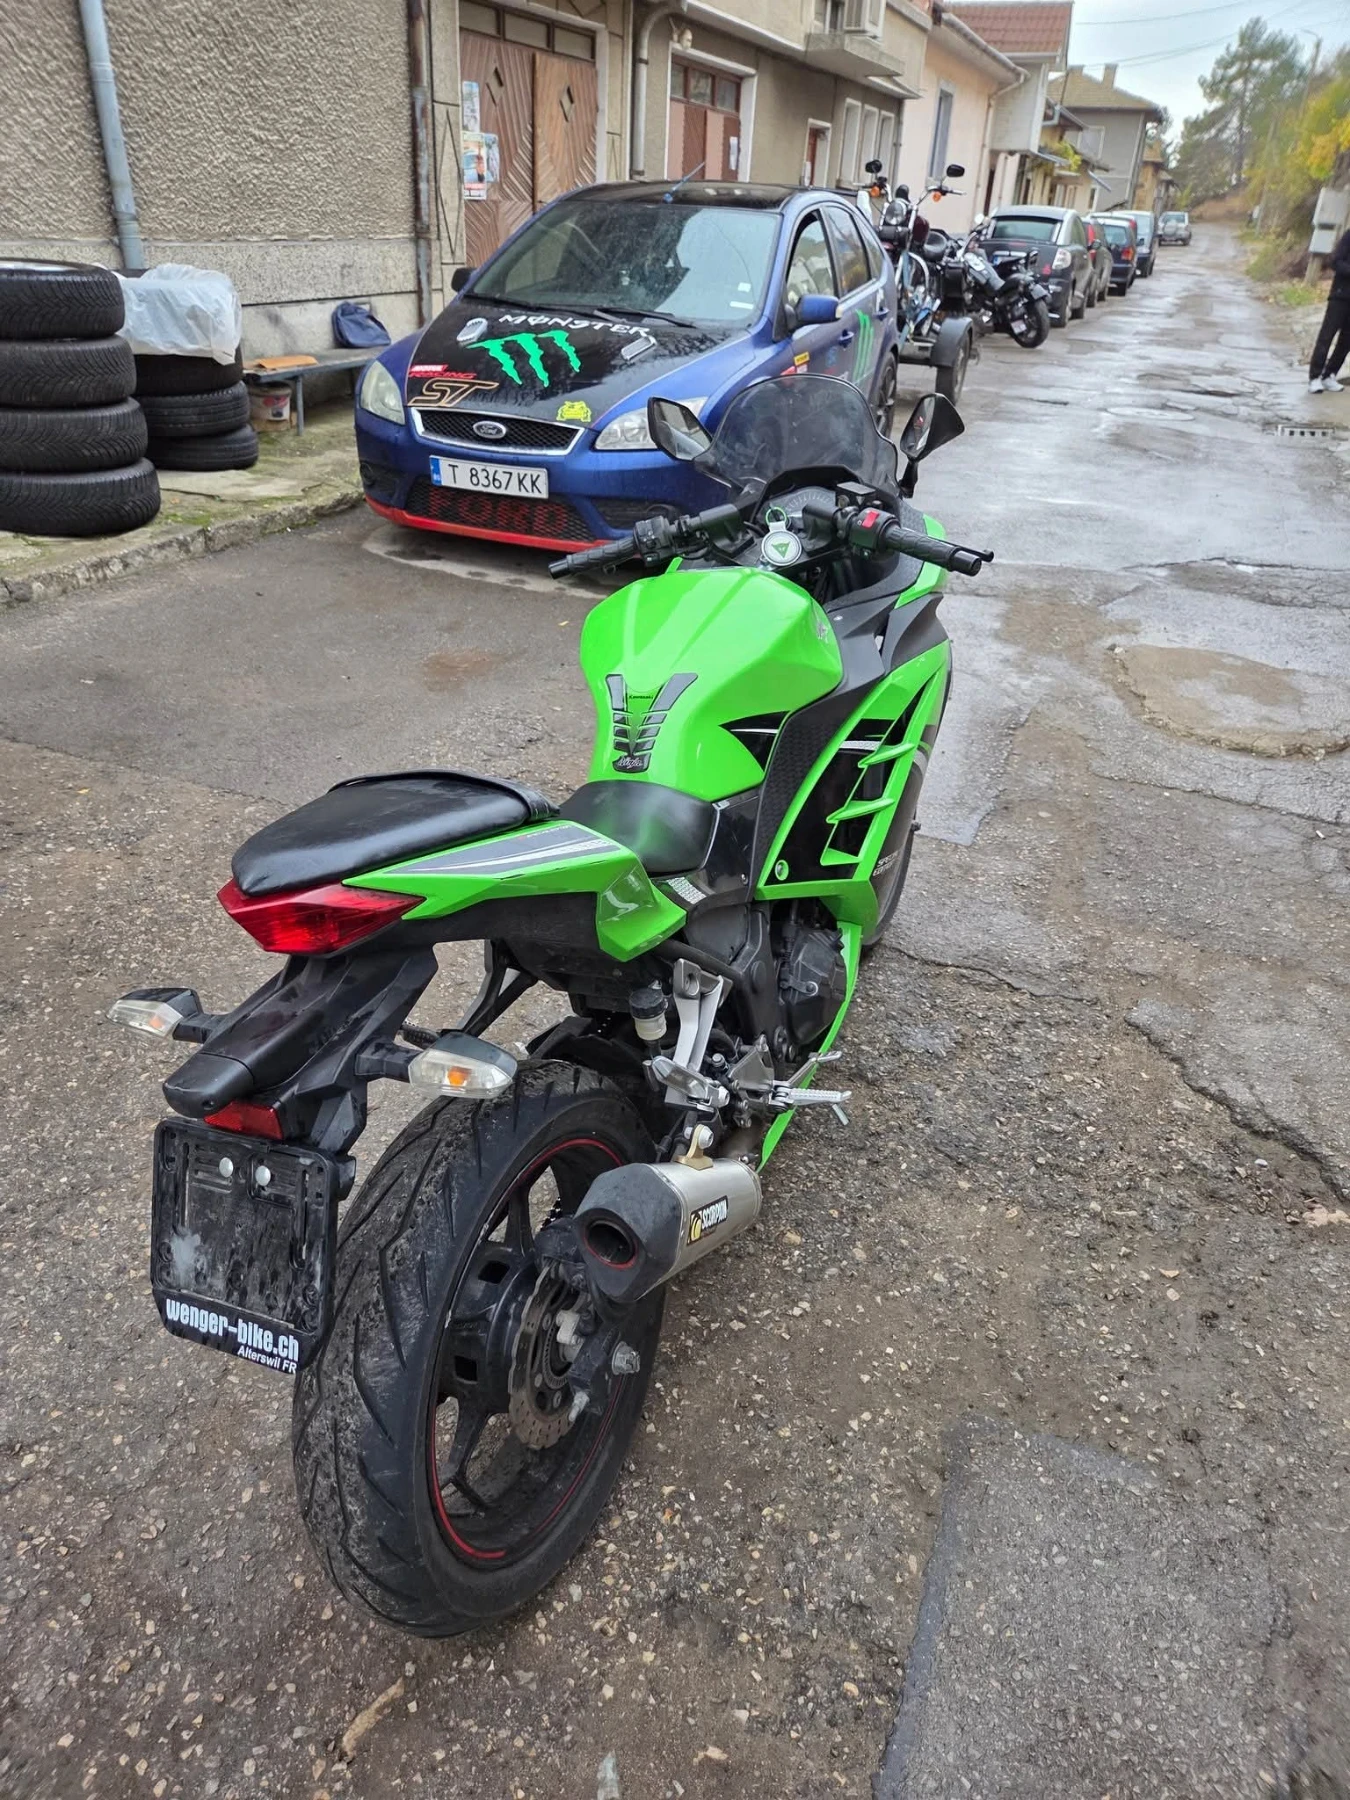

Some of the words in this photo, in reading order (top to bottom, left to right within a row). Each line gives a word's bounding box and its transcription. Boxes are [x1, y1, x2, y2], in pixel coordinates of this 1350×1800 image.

[407, 377, 500, 407] ST
[448, 463, 459, 484] T
[428, 487, 569, 533] FORD
[165, 1298, 299, 1362] wenger-bike.ch
[237, 1345, 281, 1369] Alterswil
[282, 1359, 298, 1375] FR
